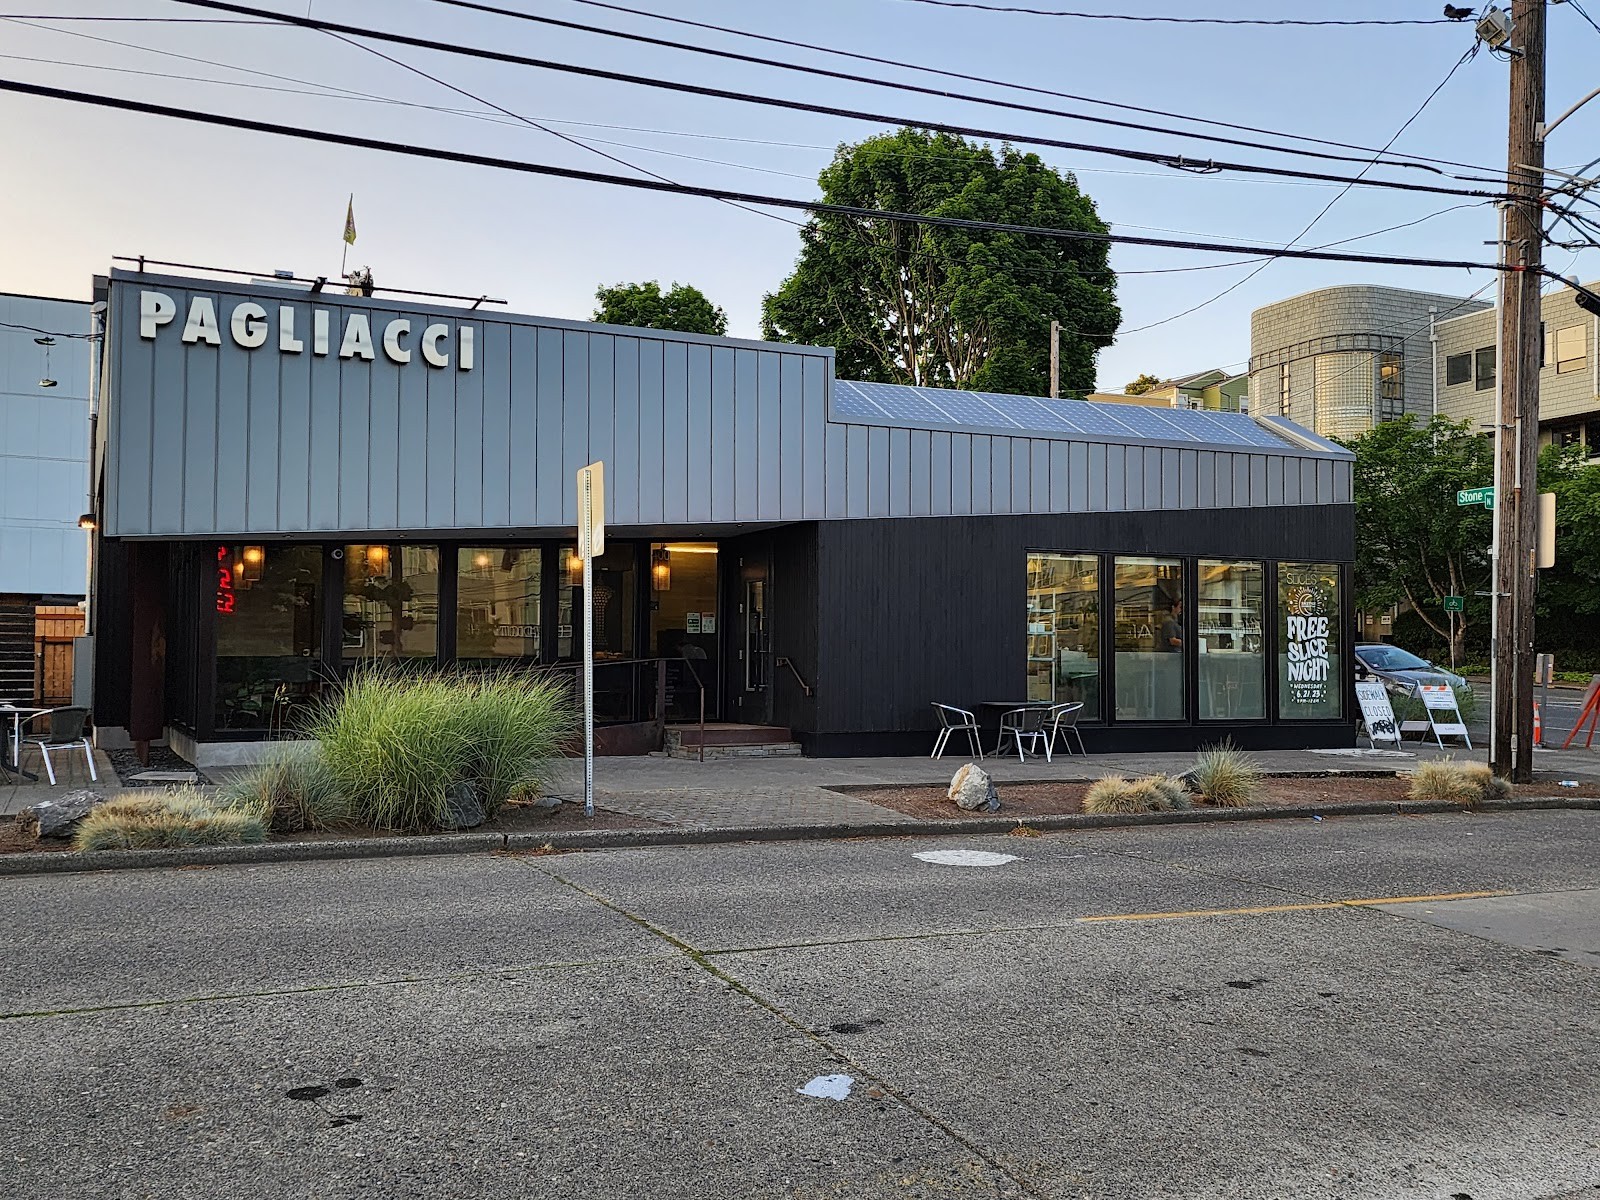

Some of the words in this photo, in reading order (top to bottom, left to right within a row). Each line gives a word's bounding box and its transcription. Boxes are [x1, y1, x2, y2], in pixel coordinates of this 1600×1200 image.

[140, 290, 475, 371] PAGLIACCI
[1459, 492, 1484, 503] Stone
[1486, 497, 1492, 505] N
[1286, 573, 1318, 585] SLICES
[1287, 616, 1330, 642] FREE
[1287, 638, 1330, 662] SLICE
[1287, 658, 1330, 682] NIGHT
[1357, 689, 1387, 701] SIDEWALK
[1363, 705, 1392, 717] CLOSED
